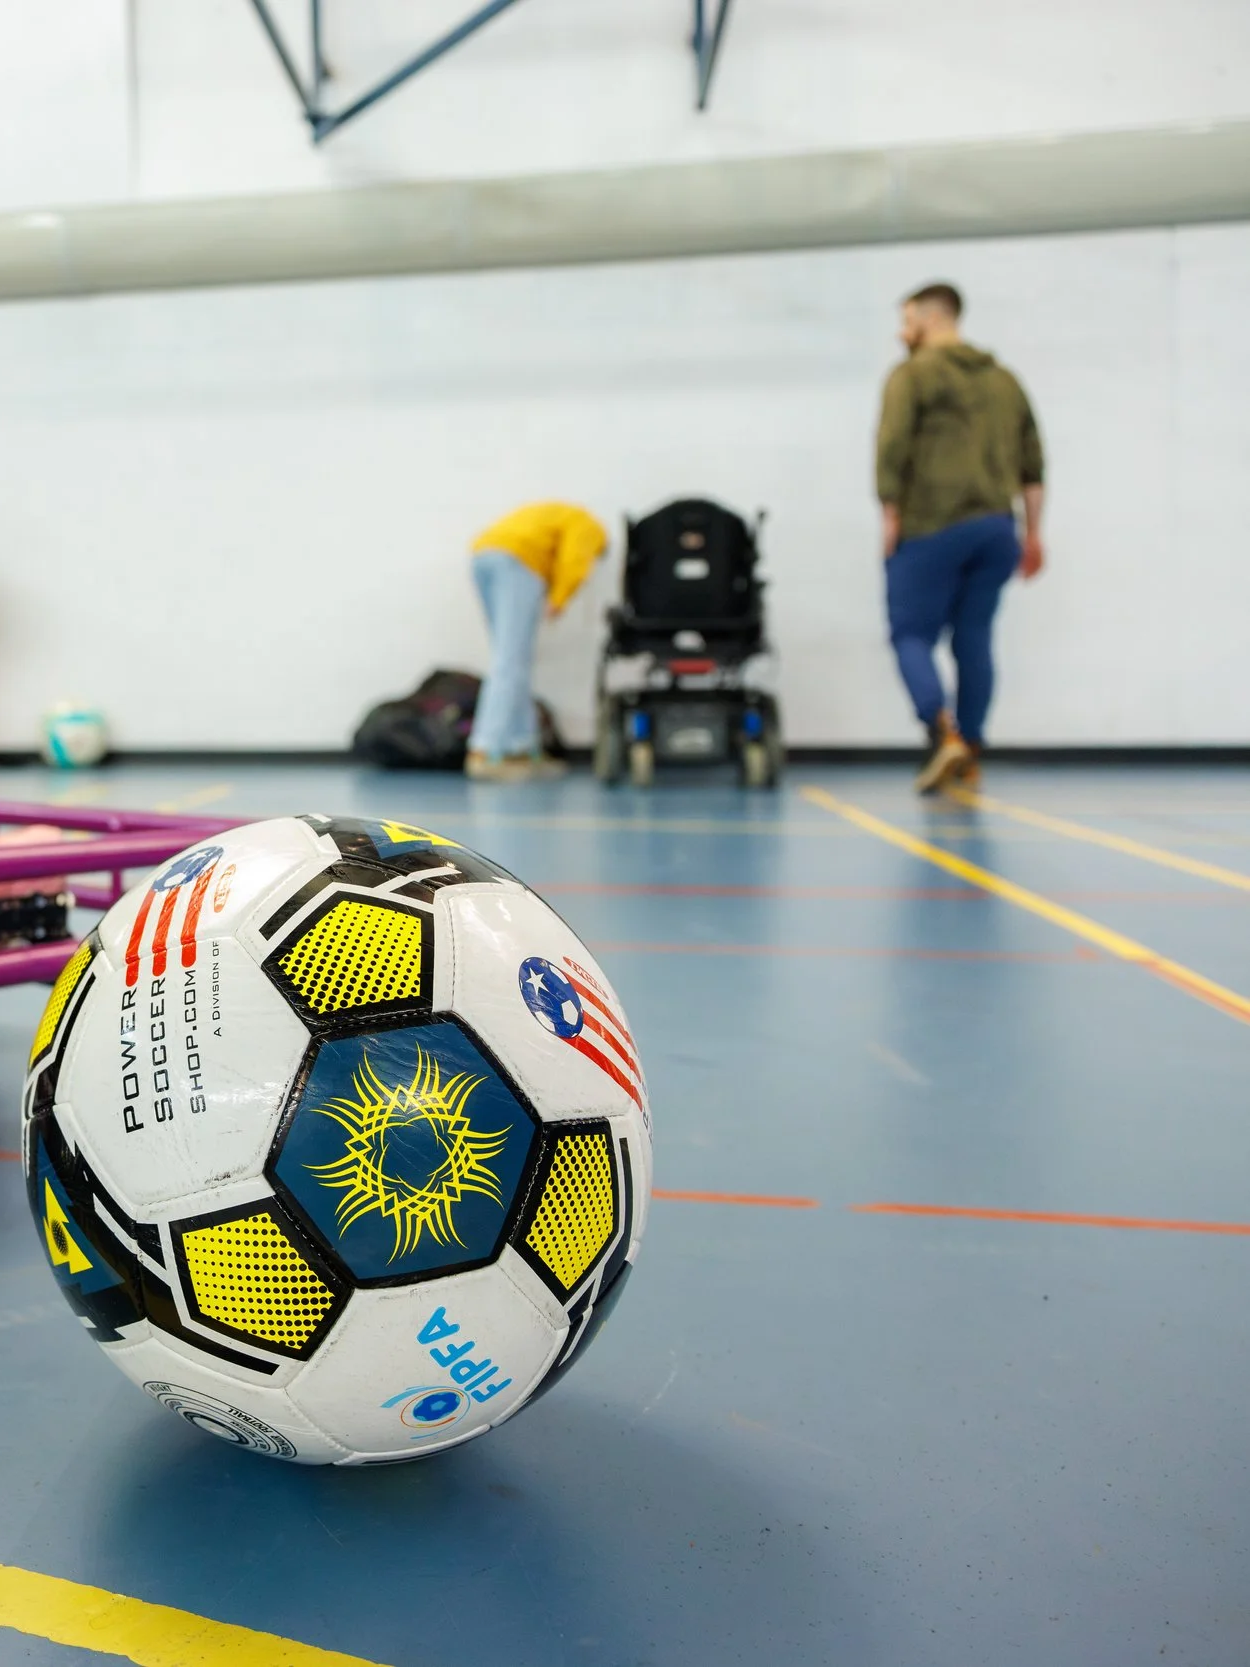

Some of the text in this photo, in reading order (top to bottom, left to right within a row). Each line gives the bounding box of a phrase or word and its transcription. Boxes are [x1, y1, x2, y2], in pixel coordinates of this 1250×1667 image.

[184, 969, 207, 1114] SHOP.COM
[211, 940, 223, 1037] A DIVISION OF
[121, 986, 144, 1134] POWER
[150, 976, 174, 1124] SOCCER
[416, 1306, 513, 1403] FIPFA
[227, 1406, 274, 1434] FOOTBALL
